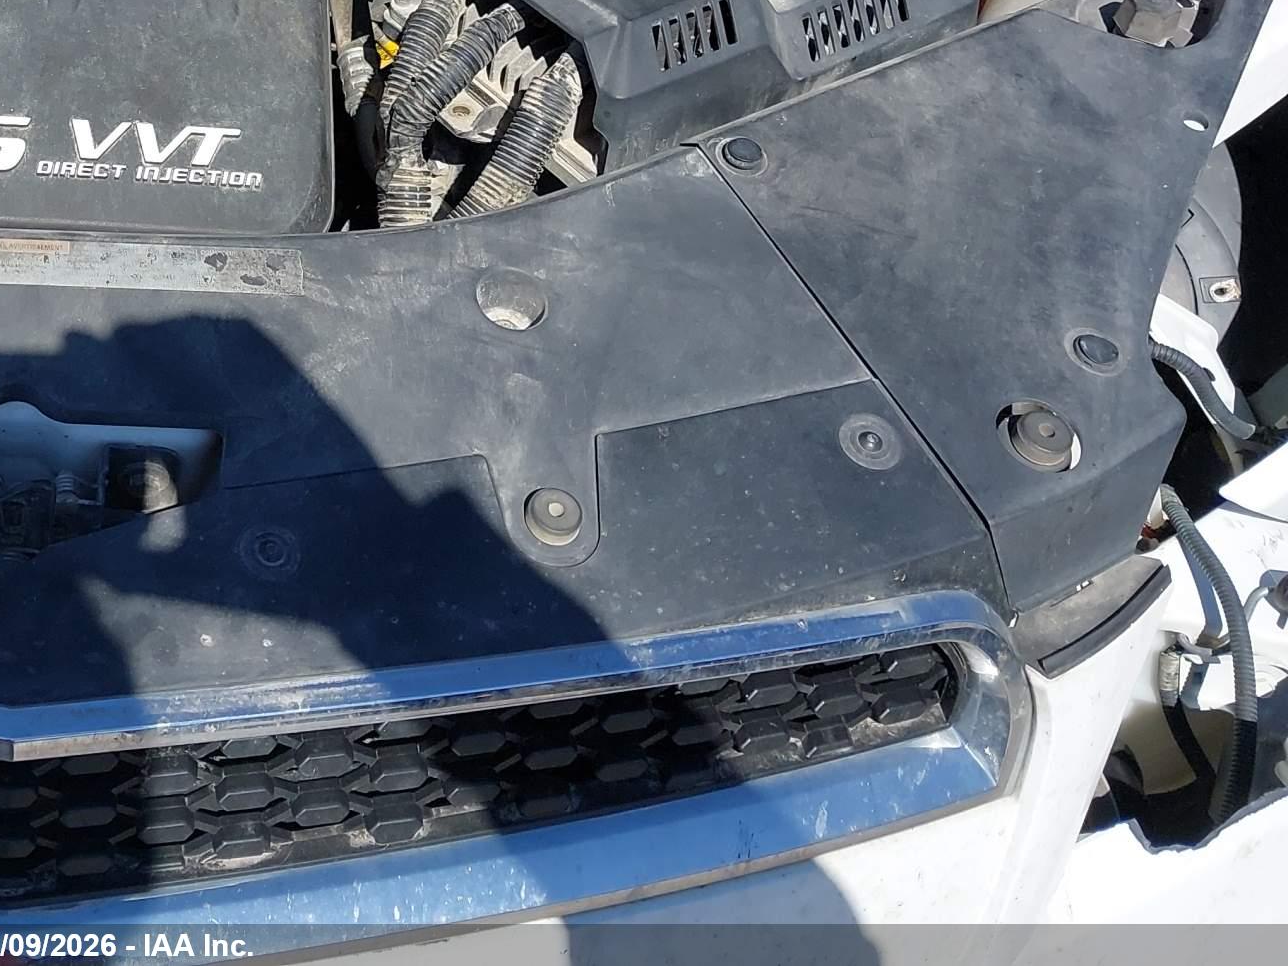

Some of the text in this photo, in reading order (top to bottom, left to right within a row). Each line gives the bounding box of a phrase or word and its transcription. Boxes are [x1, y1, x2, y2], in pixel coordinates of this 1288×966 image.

[70, 117, 242, 167] VVT
[36, 159, 264, 190] DIRECT INJECTION
